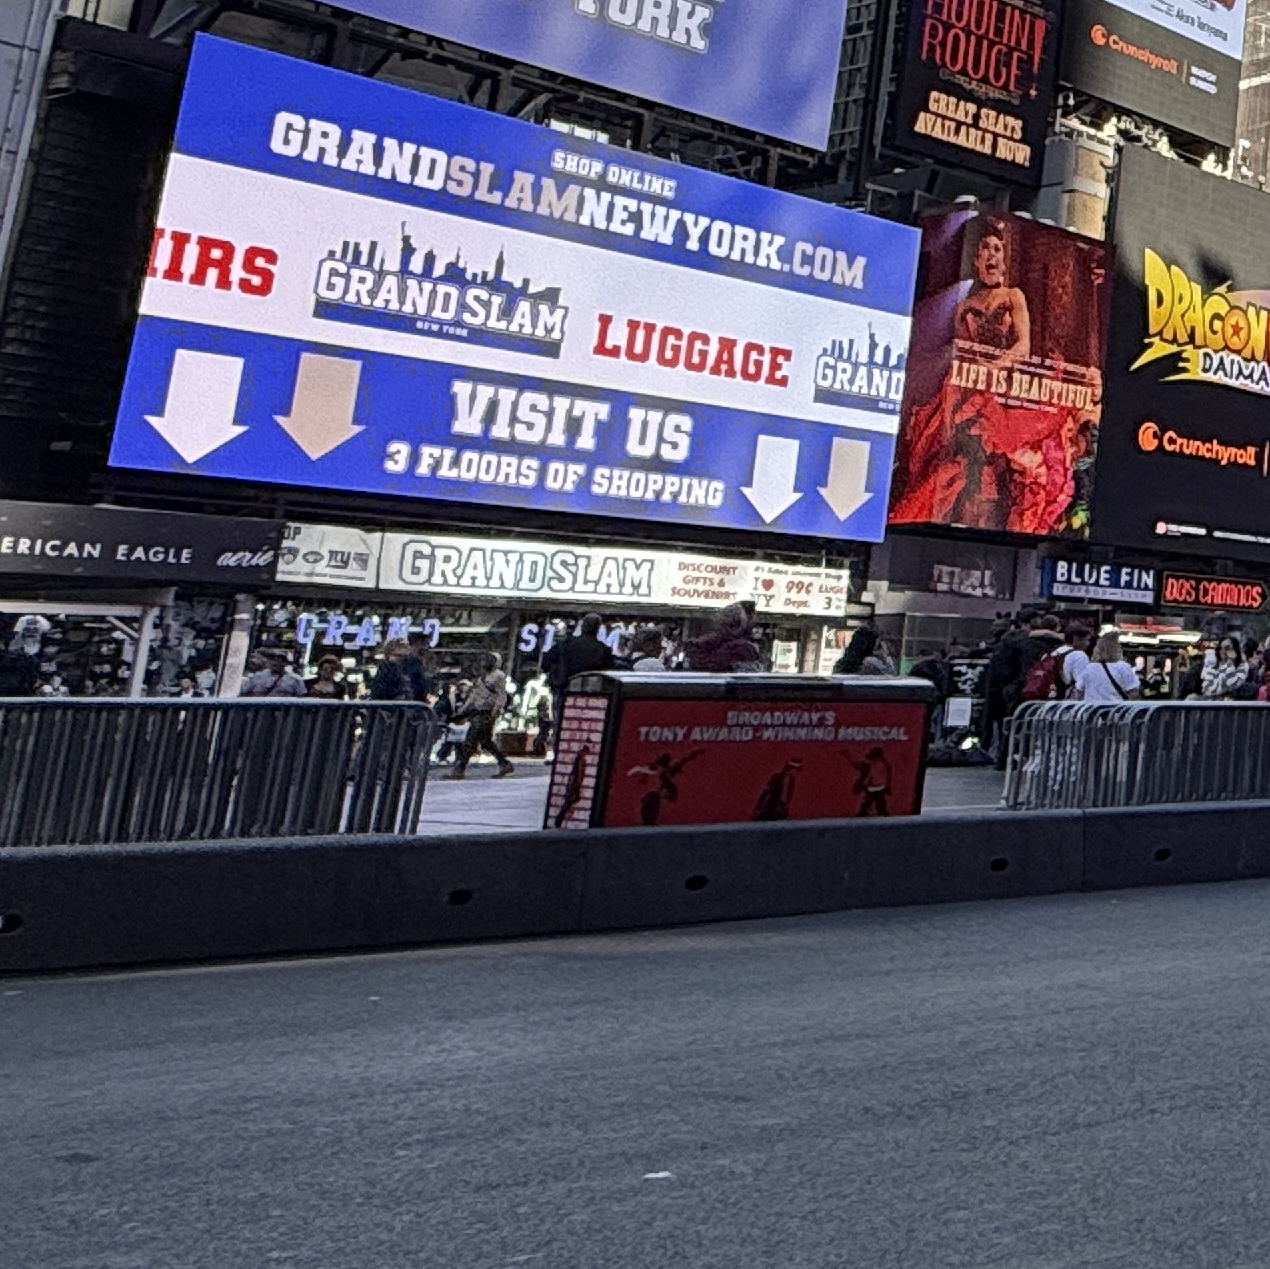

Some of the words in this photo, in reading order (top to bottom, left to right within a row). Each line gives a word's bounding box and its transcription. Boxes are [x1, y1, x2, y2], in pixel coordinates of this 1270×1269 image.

[1108, 34, 1180, 75] Crunchyroll
[928, 89, 978, 125] GREAT
[978, 106, 1024, 141] SEATS
[913, 110, 995, 156] AVAILABLE
[994, 135, 1032, 168] NOW!
[551, 149, 603, 180] SHOP
[606, 163, 678, 198] ONLINE
[268, 111, 868, 291] GRANDSLAMNEWYORK.COM
[1144, 246, 1269, 362] DRAGON
[592, 313, 794, 390] LUGGAGE
[950, 359, 988, 390] LIFE
[990, 368, 1008, 394] IS
[451, 380, 607, 451] VISIT
[625, 408, 694, 464] US
[1161, 429, 1257, 467] Crunchyroll
[385, 442, 410, 476] 3
[417, 445, 539, 490] FLOORS
[546, 456, 588, 495] OF
[592, 463, 725, 510] SHOPPING
[0, 535, 102, 560] ERICAN
[115, 543, 194, 566] EAGLE
[216, 544, 275, 569] aerie
[678, 561, 739, 576] DISCOUNT
[1055, 560, 1112, 587] BLUE
[1120, 566, 1155, 590] FIN
[1164, 576, 1196, 602] DOS
[822, 596, 833, 610] 3
[638, 725, 688, 742] TONY
[837, 725, 909, 742] MUSICAL
[726, 710, 836, 727] BROADWAY'S
